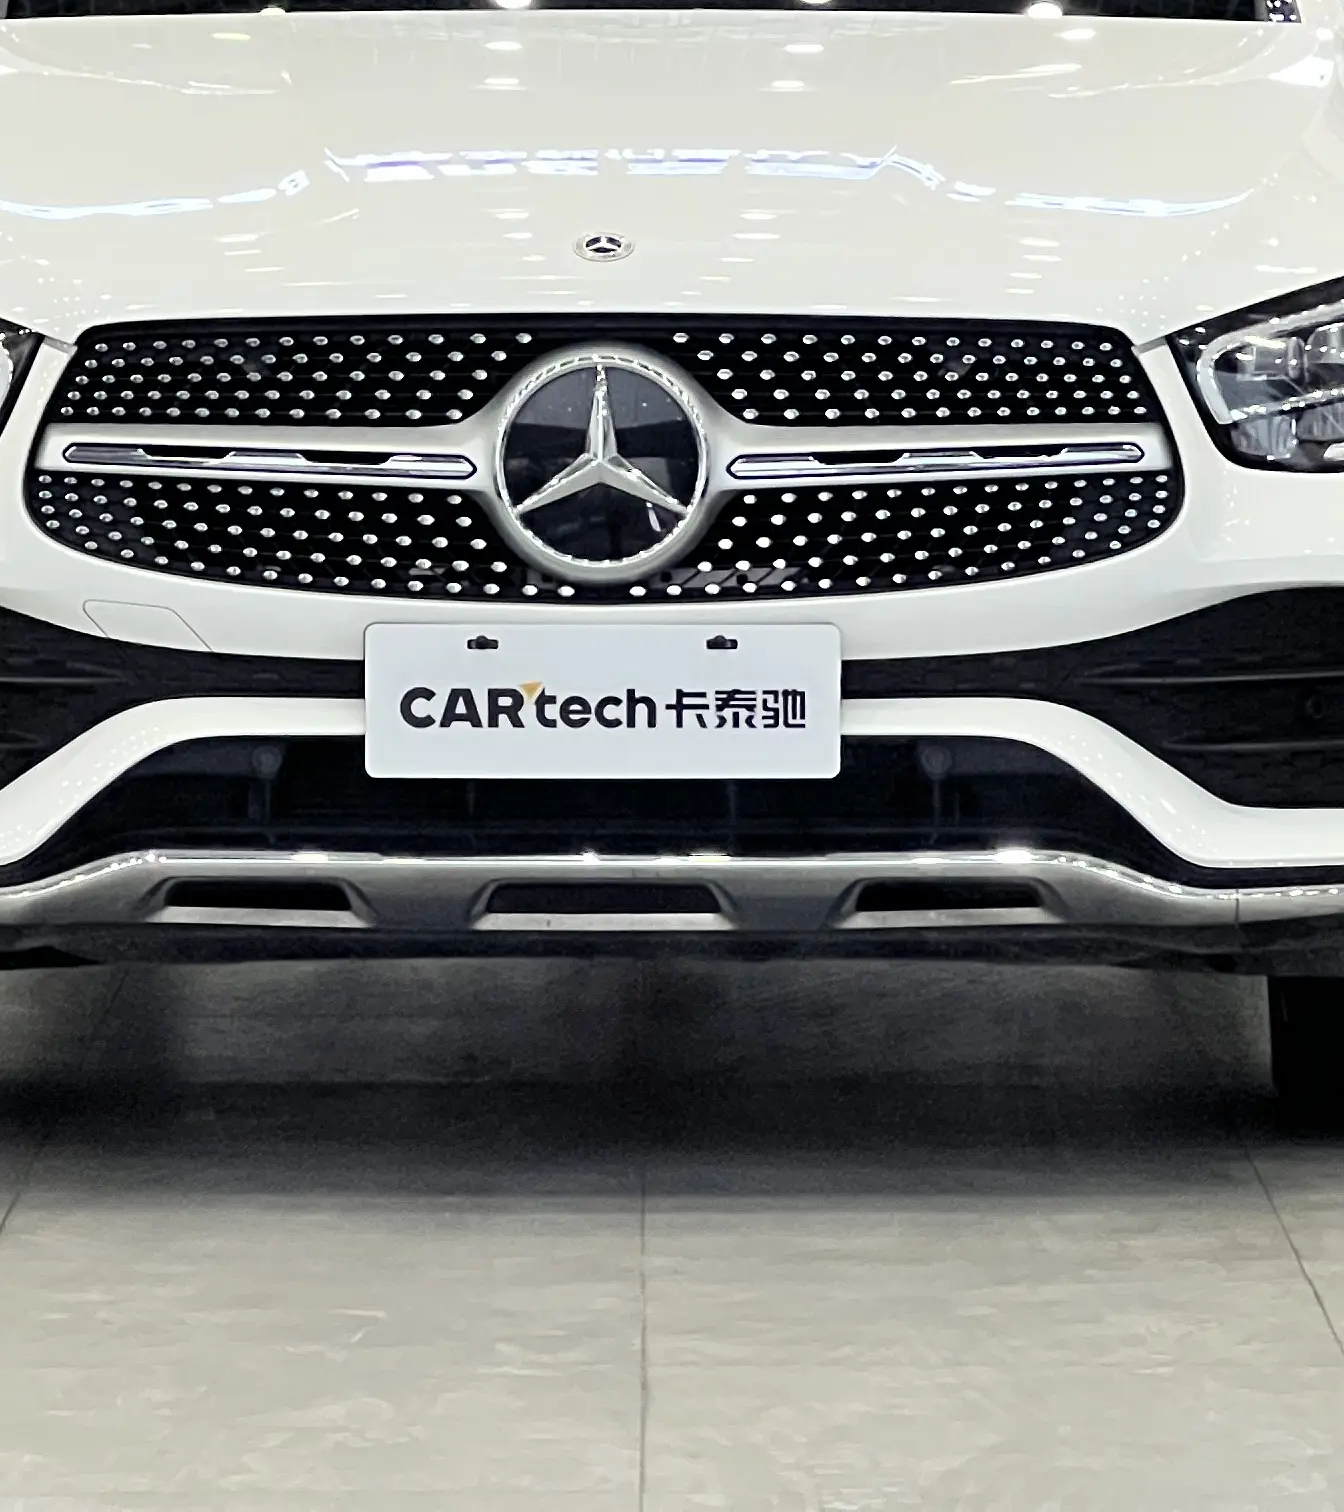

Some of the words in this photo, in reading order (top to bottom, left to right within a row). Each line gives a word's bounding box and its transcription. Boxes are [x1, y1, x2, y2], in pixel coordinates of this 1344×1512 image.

[399, 683, 657, 729] CARtech
[665, 688, 807, 729] 卡泰驰
